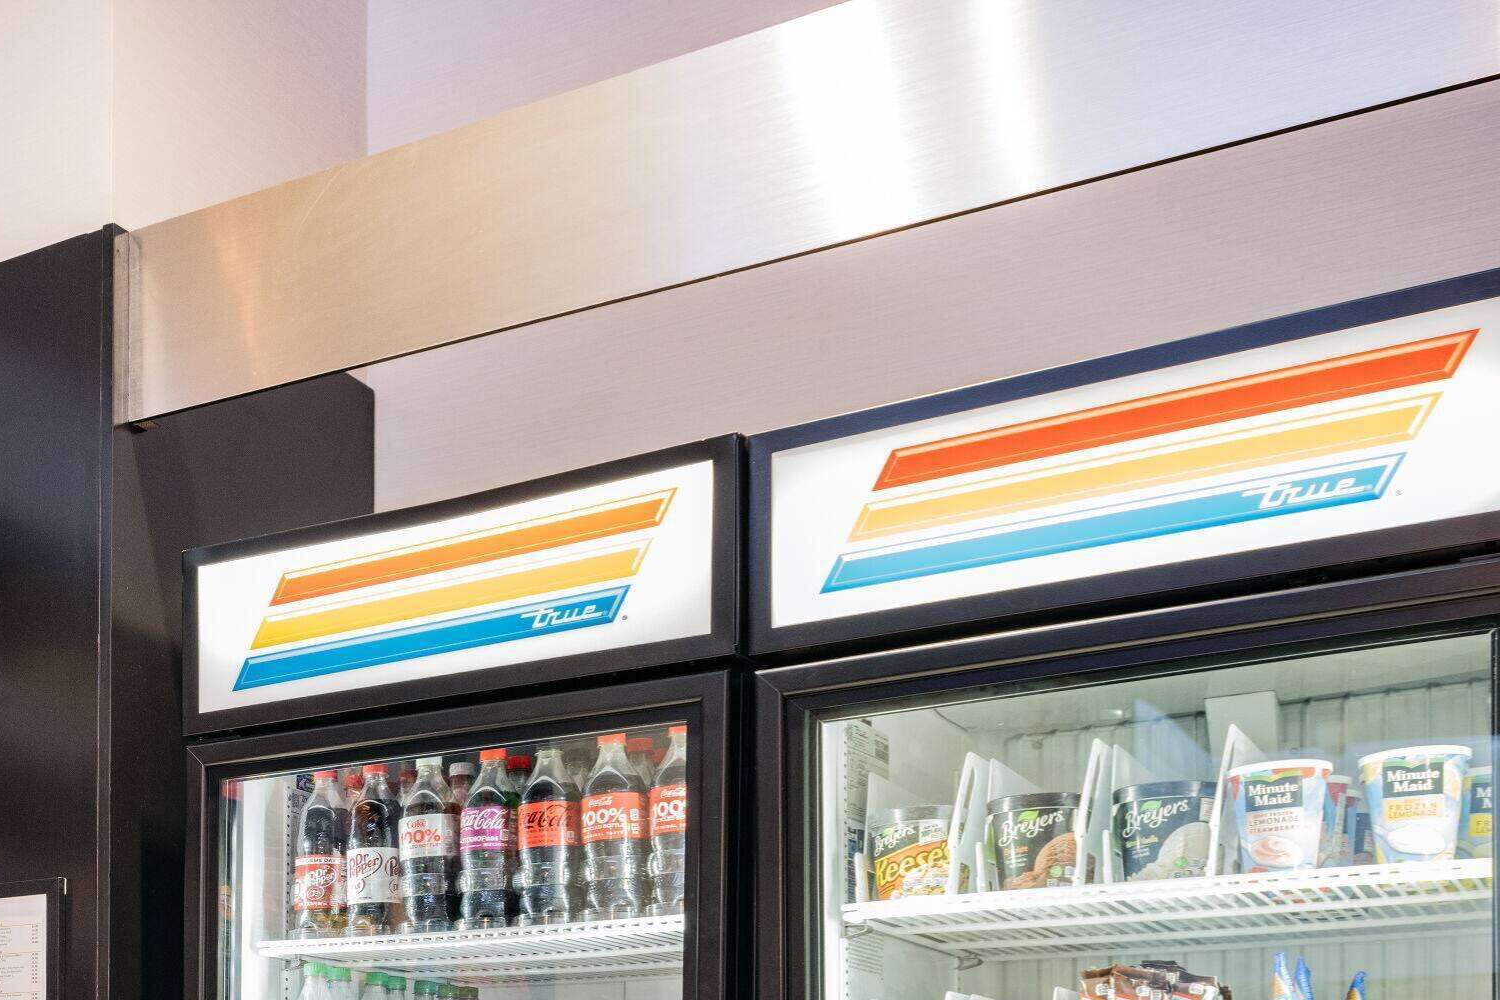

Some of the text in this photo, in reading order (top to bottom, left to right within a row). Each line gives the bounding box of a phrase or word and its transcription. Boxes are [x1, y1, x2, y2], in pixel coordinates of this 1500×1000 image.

[1242, 477, 1370, 510] true
[520, 604, 607, 630] true
[1386, 768, 1440, 783] Minute
[1249, 782, 1299, 797] Minute
[1393, 781, 1433, 793] Maid
[1254, 793, 1293, 807] Maid
[581, 808, 626, 827] 100%
[998, 809, 1066, 847] Breyers
[1122, 799, 1190, 838] Breyers
[873, 824, 916, 857] Breyers
